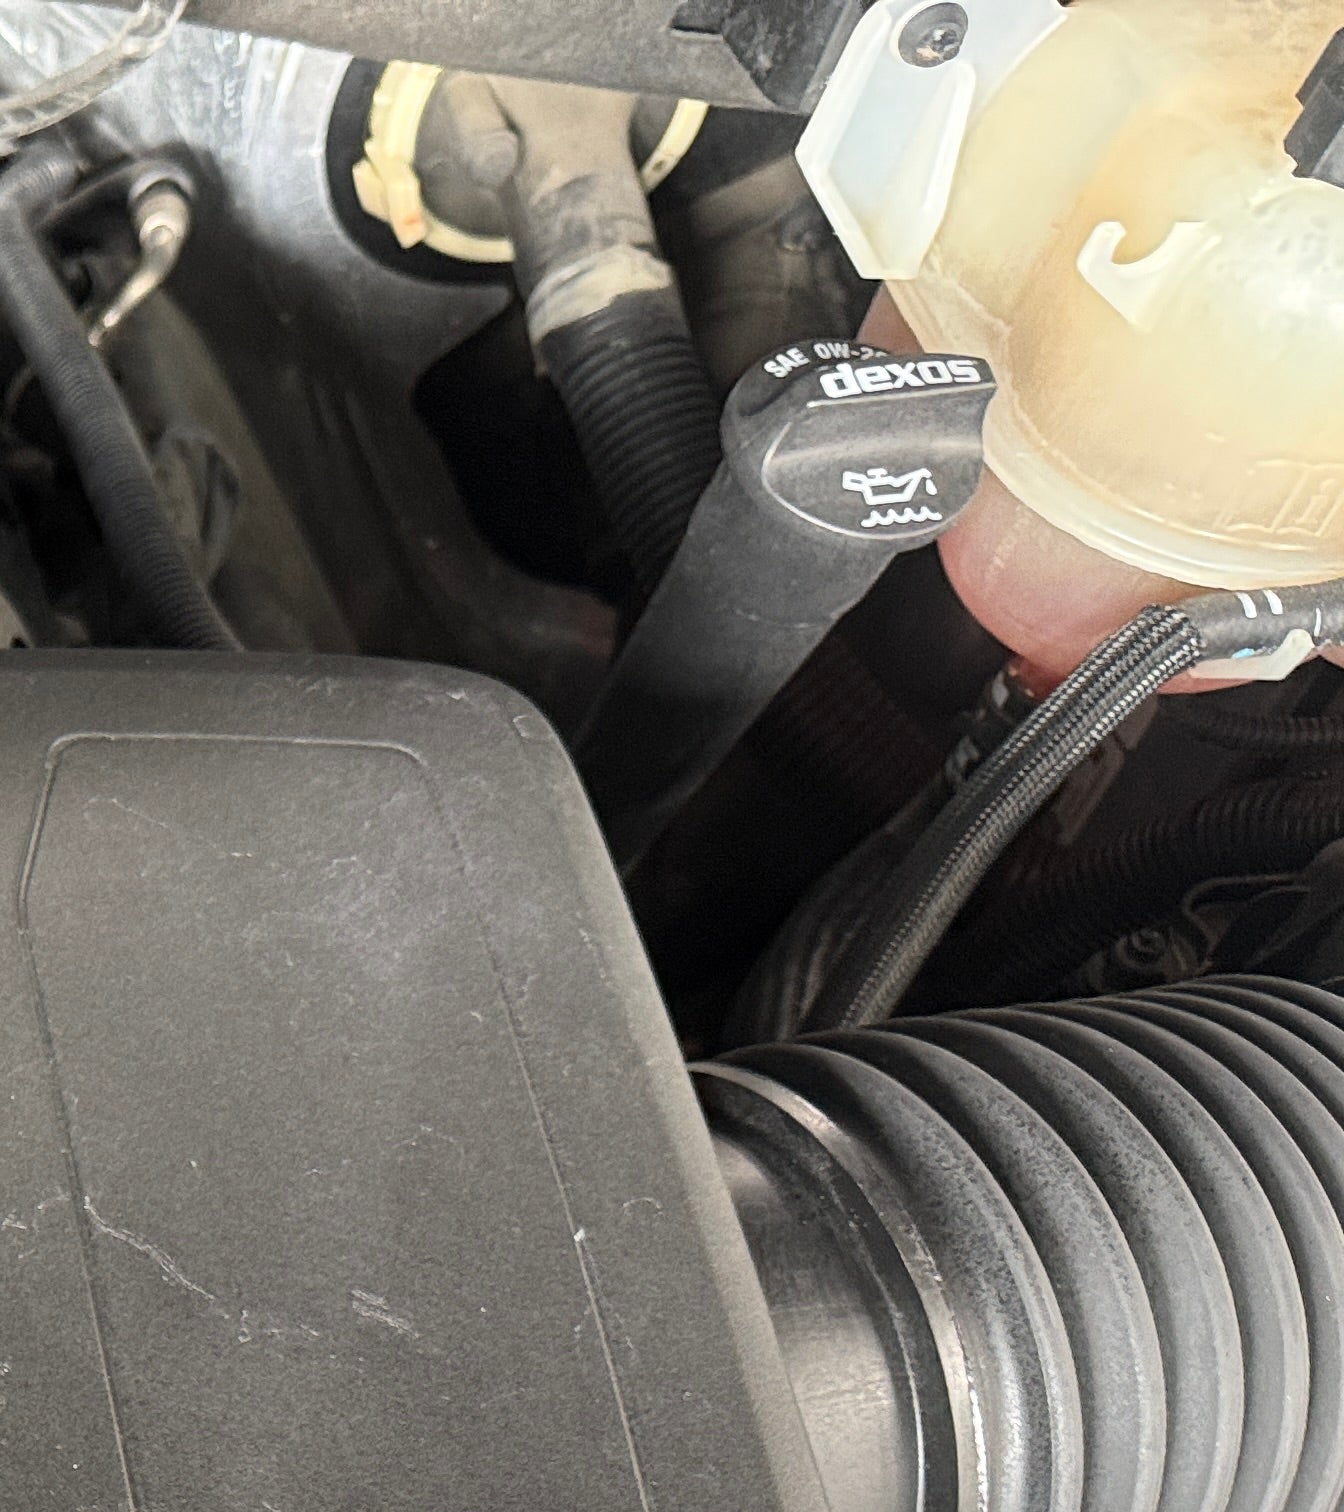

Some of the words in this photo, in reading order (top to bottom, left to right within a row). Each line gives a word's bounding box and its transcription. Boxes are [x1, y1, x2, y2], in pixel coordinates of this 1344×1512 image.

[764, 347, 810, 378] SAE
[813, 342, 889, 361] 0W-2
[819, 359, 981, 399] dexos
